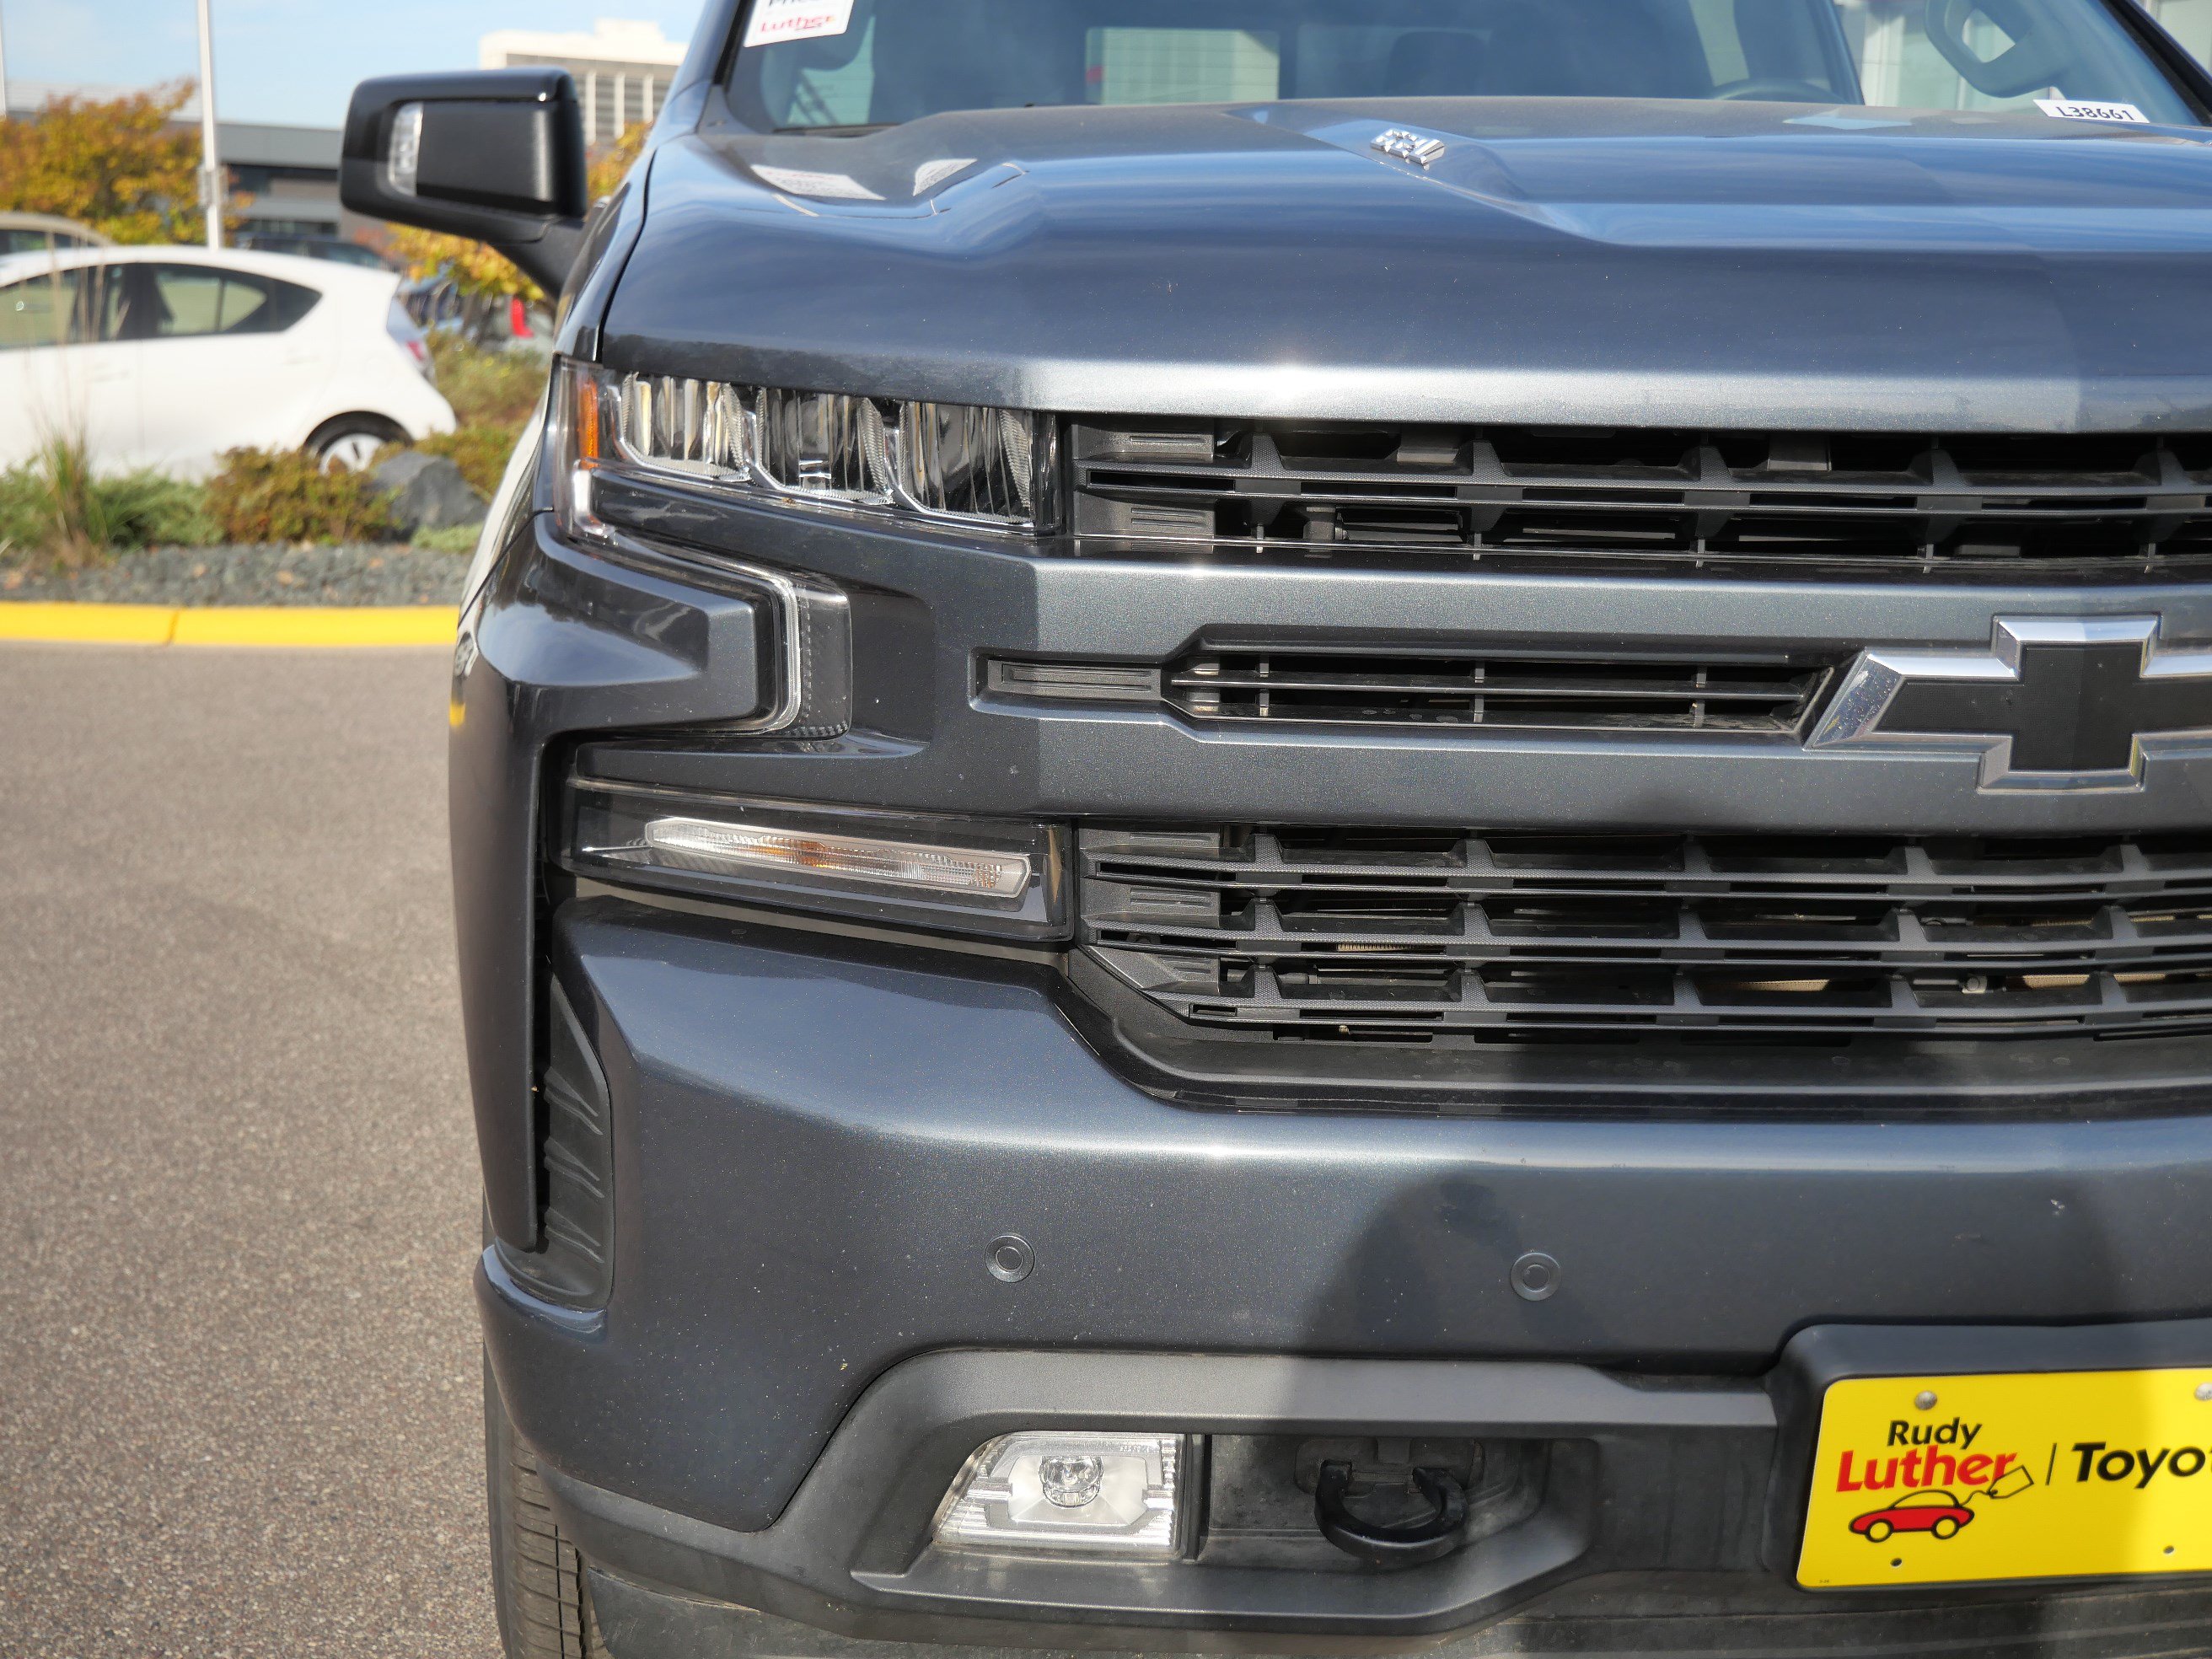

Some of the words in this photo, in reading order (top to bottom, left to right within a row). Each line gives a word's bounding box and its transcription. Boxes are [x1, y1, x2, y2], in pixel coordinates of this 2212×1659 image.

[2055, 106, 2134, 121] L38661
[1887, 1416, 1983, 1451] Rudy
[1835, 1444, 2018, 1493] Luther
[2070, 1441, 2212, 1490] Toyo
